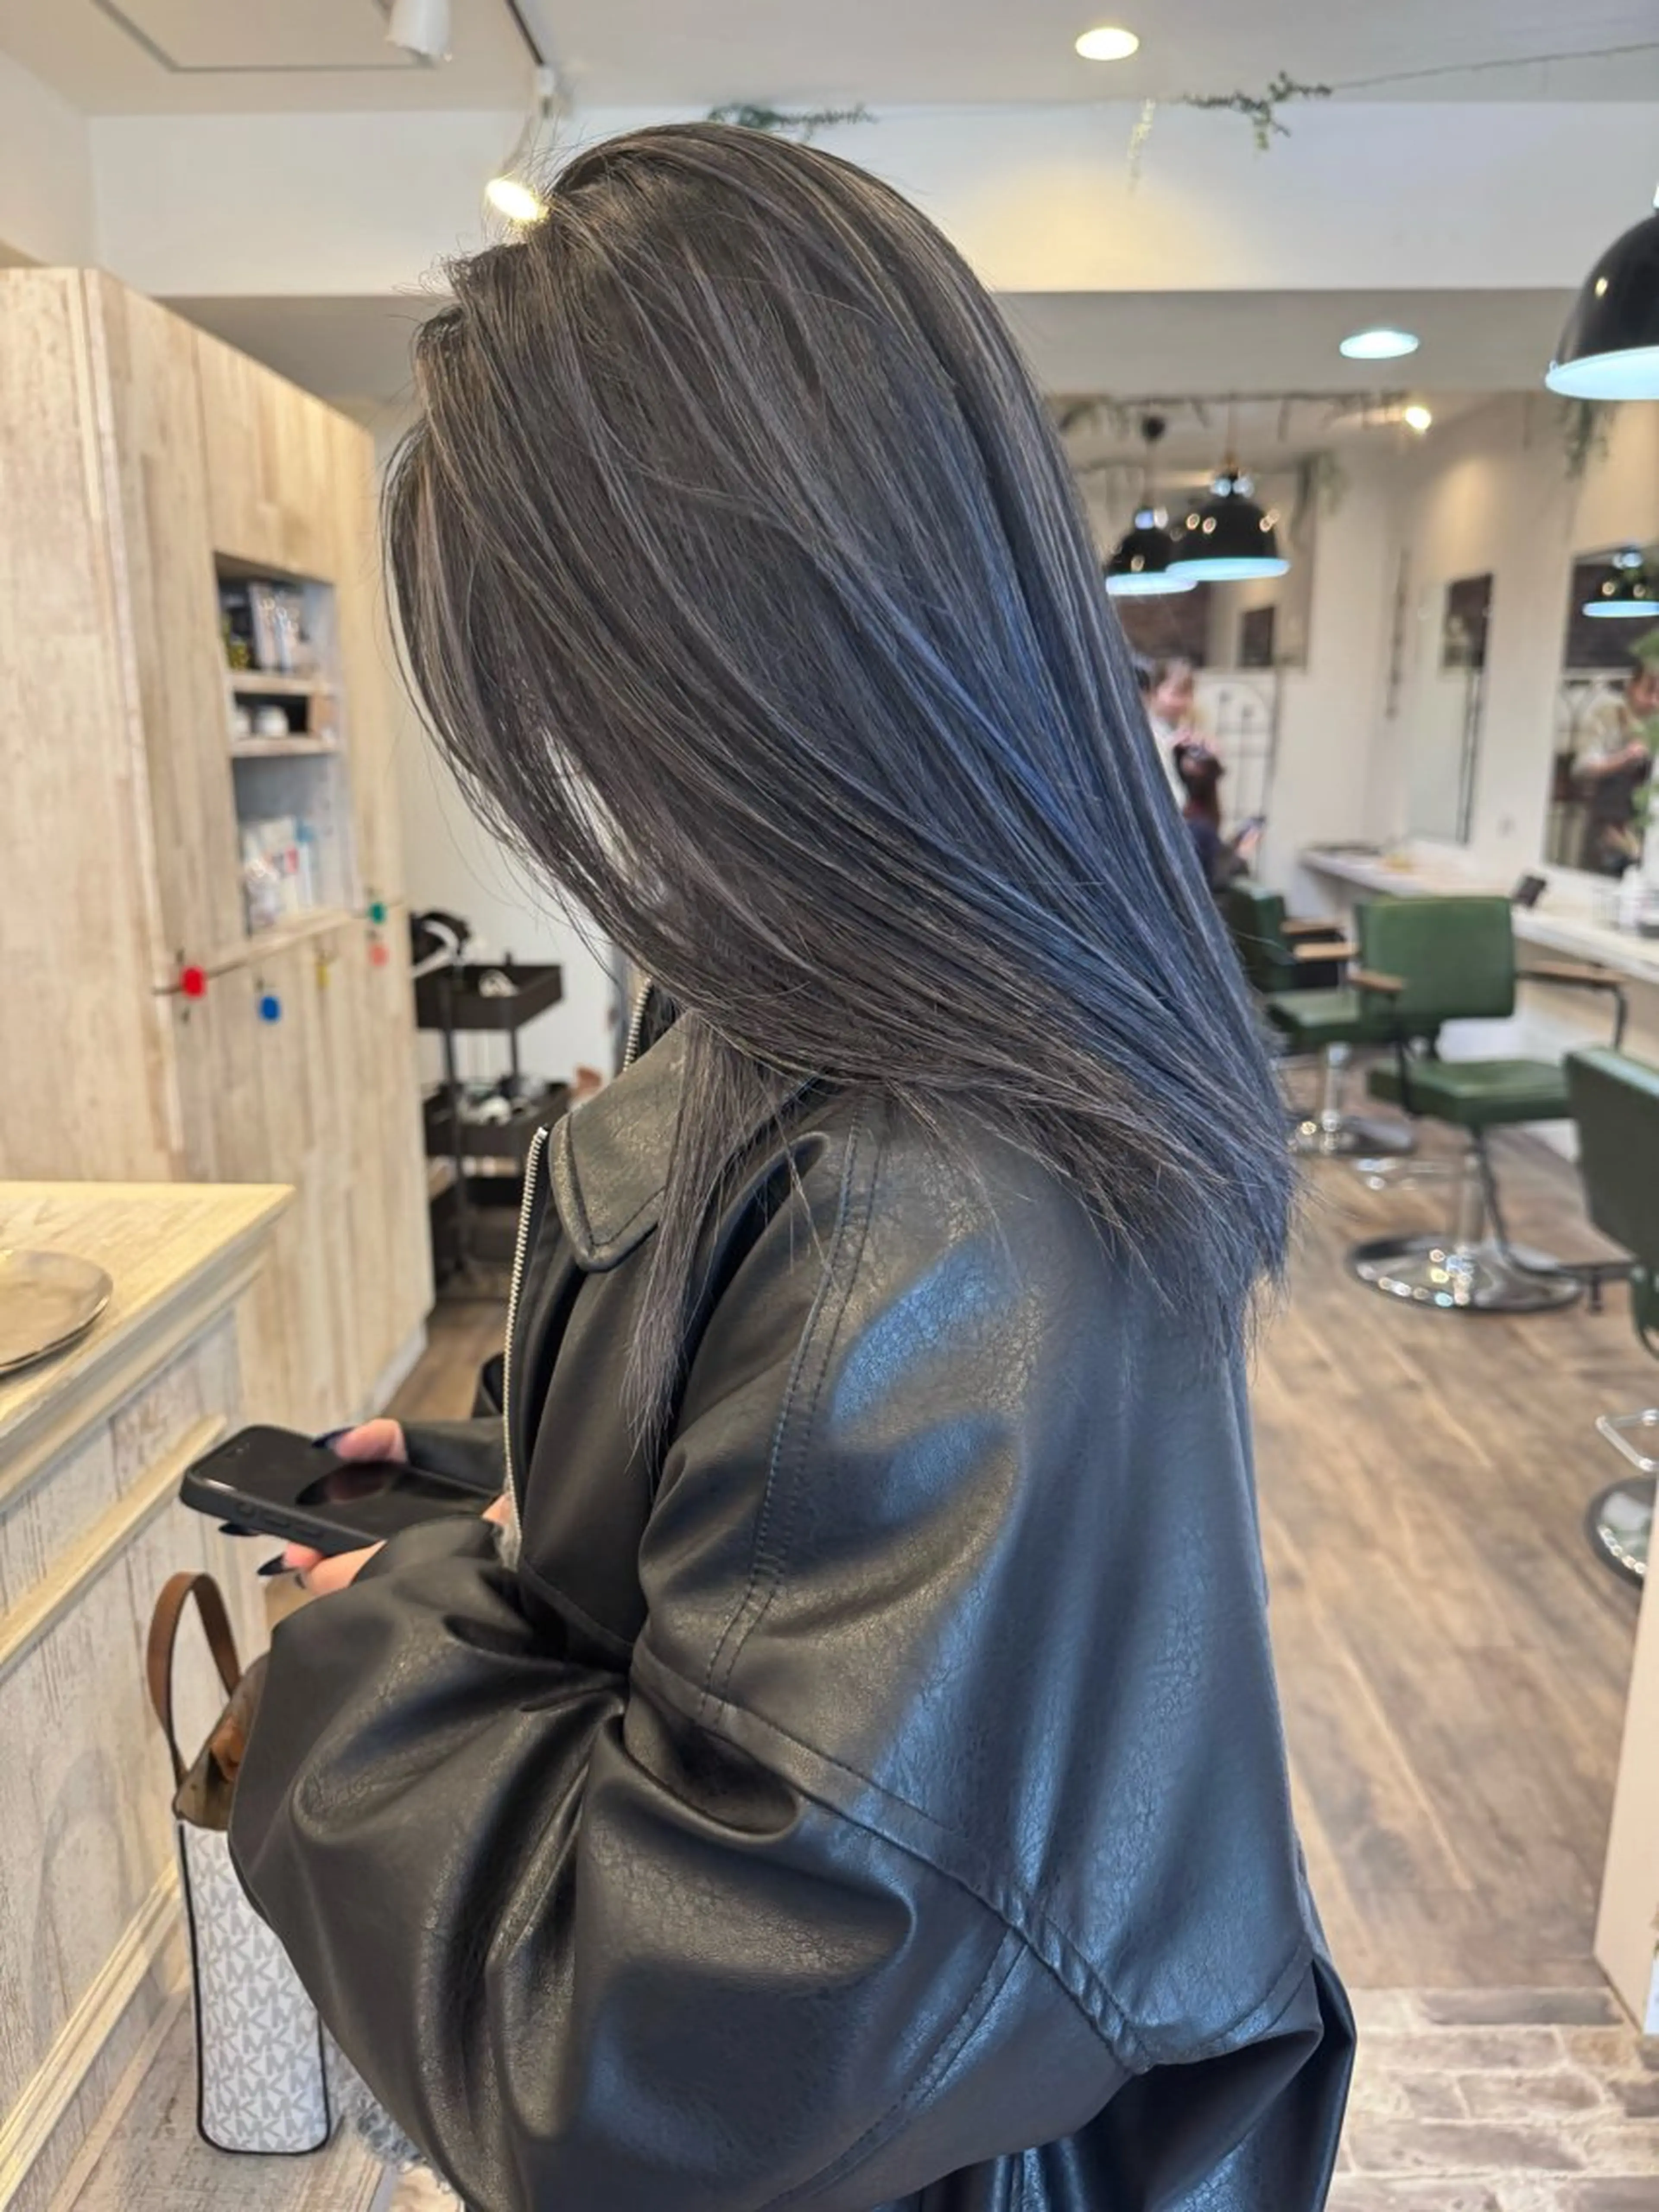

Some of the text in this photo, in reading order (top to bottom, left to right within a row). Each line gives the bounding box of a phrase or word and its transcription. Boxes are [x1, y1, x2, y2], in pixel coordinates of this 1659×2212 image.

[227, 1960, 274, 1983] MK
[247, 1978, 299, 2009] MK
[222, 2006, 268, 2031] MK
[242, 2026, 295, 2054] MK
[219, 2049, 264, 2076] MK
[266, 2041, 316, 2076] MK
[239, 2073, 287, 2098] MK
[216, 2091, 313, 2120] MK MK
[236, 2118, 282, 2139] MK
